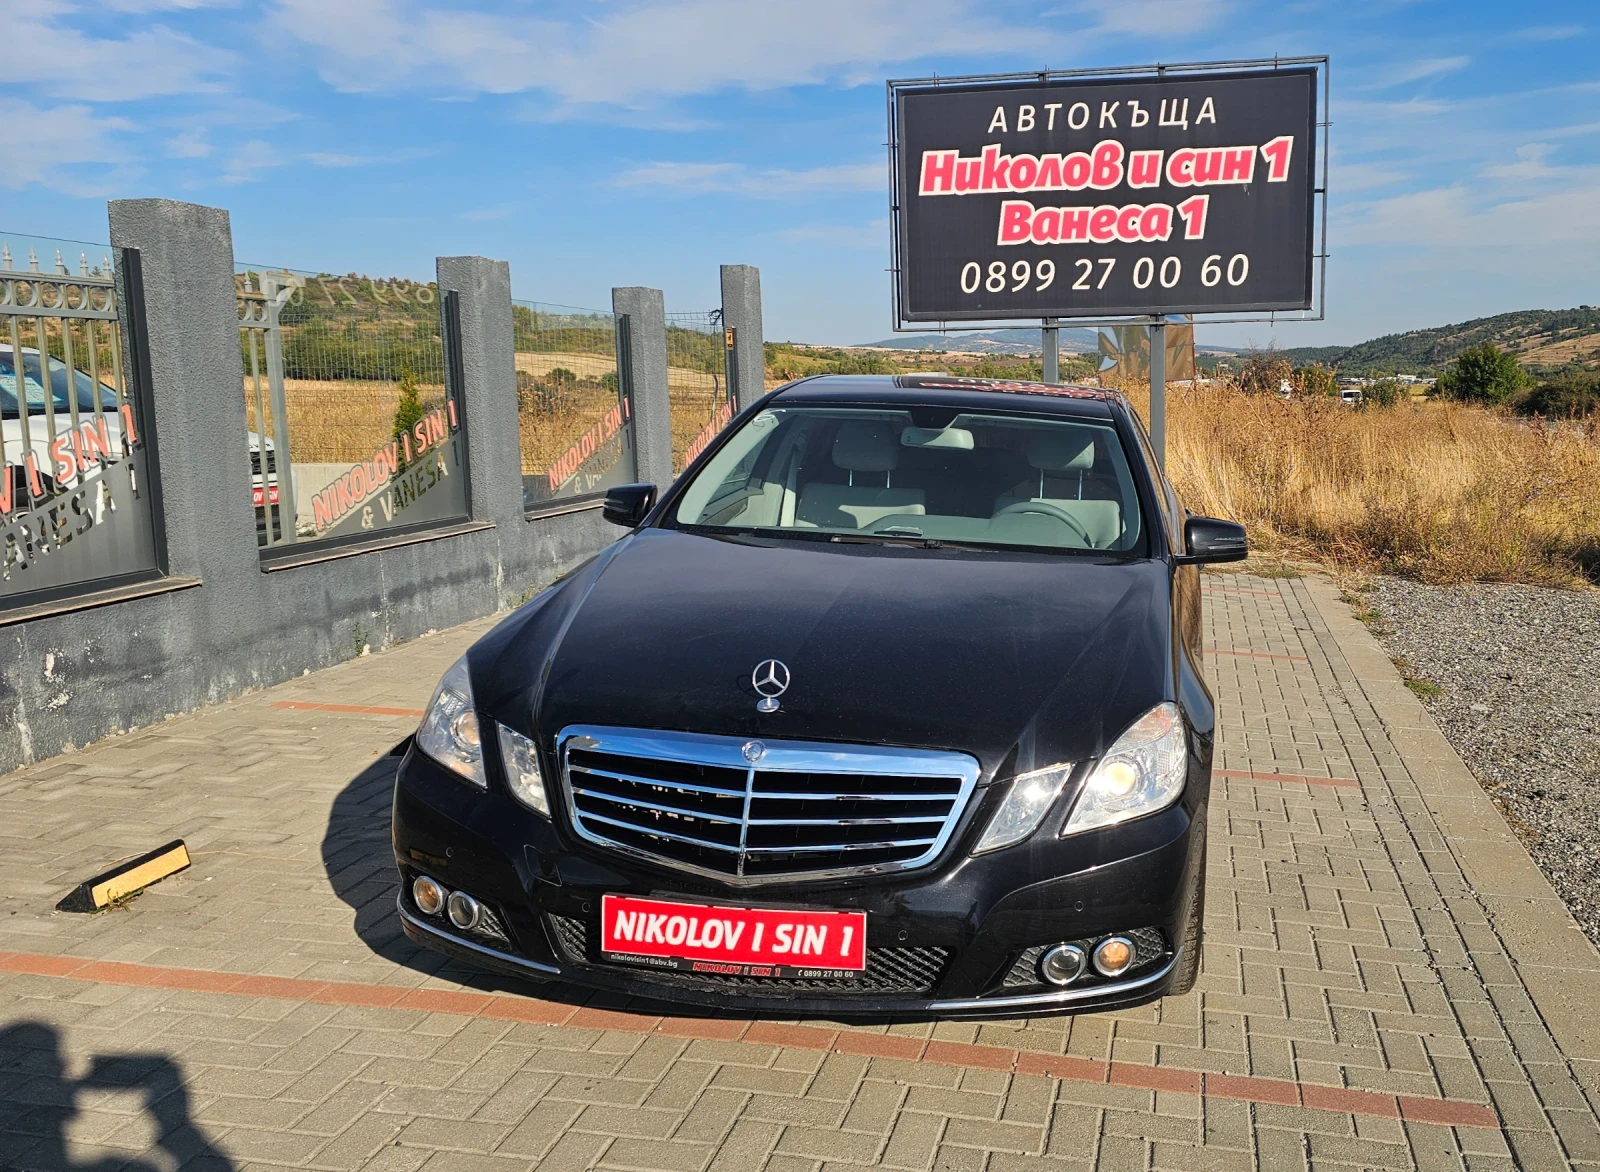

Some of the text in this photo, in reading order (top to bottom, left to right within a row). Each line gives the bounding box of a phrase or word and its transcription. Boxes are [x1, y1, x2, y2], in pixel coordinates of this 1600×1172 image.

[988, 97, 1217, 133] АВТОКЪЩА
[919, 135, 1295, 196] Николов и син 1
[997, 194, 1209, 245] Ванеса 1
[960, 253, 1250, 294] 0899 27 00 60
[50, 415, 111, 486] SIN
[313, 440, 398, 530] NIKOLOV
[414, 409, 445, 454] SIN
[548, 427, 596, 491] NIKOLOV
[604, 404, 622, 437] SIN
[379, 451, 449, 523] VANESA
[3, 480, 118, 581] ANESA
[613, 910, 746, 951] NIKOLOV
[771, 923, 828, 956] SIN
[840, 925, 854, 957] 1
[610, 953, 678, 969] nikolovisin1@abv.bg
[693, 962, 742, 975] NIKOLOV
[751, 966, 772, 977] SIN
[804, 970, 854, 979] 0899 27 00 60
